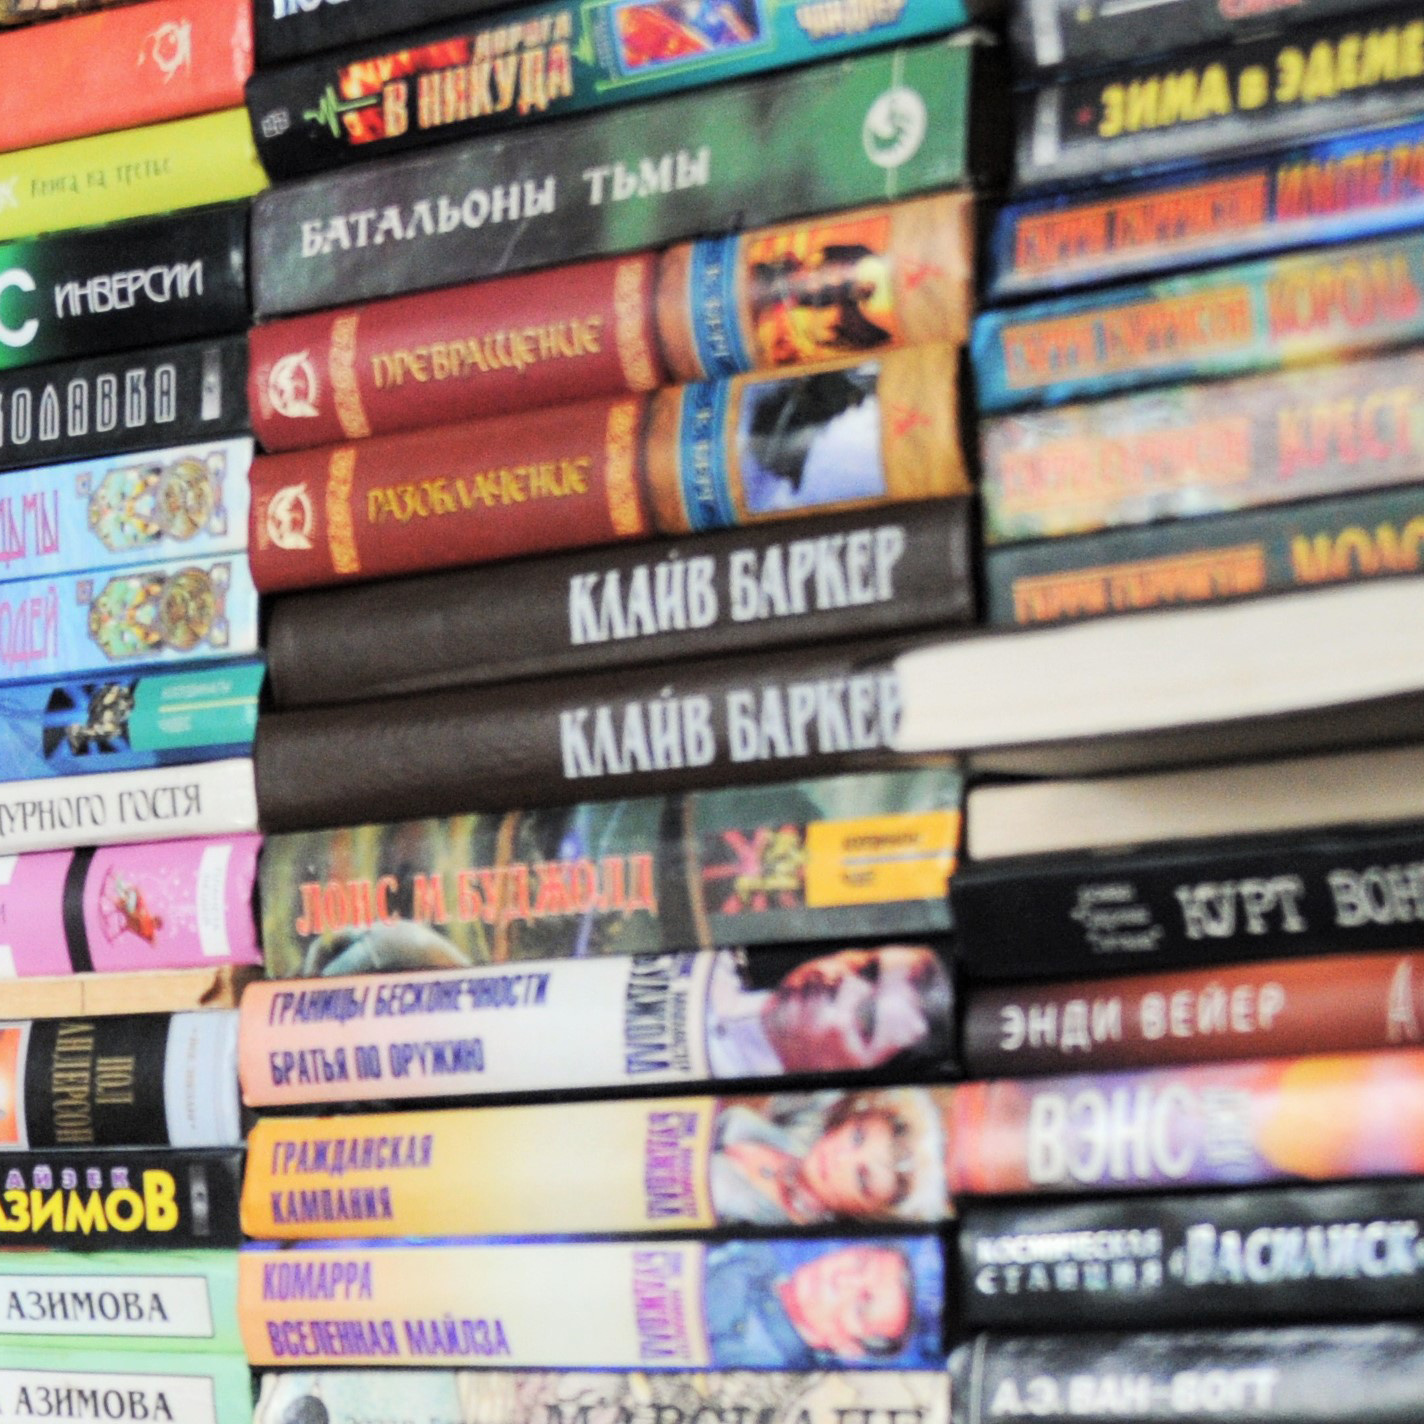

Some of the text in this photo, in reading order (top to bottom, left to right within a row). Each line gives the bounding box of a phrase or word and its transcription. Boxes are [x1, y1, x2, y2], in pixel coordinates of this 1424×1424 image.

[1099, 62, 1231, 137] ЗИМА
[301, 148, 711, 259] БАТАЛЬОНЫ ТЬМЫ
[54, 259, 204, 319] ИНВЕРСИИ
[372, 315, 604, 391] ПРЕВРАЩЕНИЕ
[569, 524, 906, 645] КЛАЙВ БАРКЕР
[559, 686, 715, 780] КЛАЙВ
[118, 783, 203, 825] ГОСТЯ
[457, 852, 656, 922] БУДЖОЛД
[268, 972, 552, 1026] ГРАНИЦЫ БЕСКОНЕЧНОСТИ
[998, 981, 1286, 1053] ЭНДИ ВЕЙЕР
[269, 1045, 350, 1088] БРАТЬЯ
[389, 1036, 486, 1078] ОРУЖИЮ
[270, 1134, 434, 1175] ГРАЖДАНСКАЯ
[1025, 1085, 1198, 1185] ВЭНС
[5, 1164, 130, 1191] АЙЗЕК
[269, 1187, 393, 1225] КАМПАНИЯ
[6, 1288, 170, 1325] АЗИМОВА
[263, 1261, 373, 1301] КОМАРРА
[265, 1314, 512, 1358] ВСЕЛЕННАЯ МАЙЛЗА
[14, 1383, 176, 1422] АЗИМОВА
